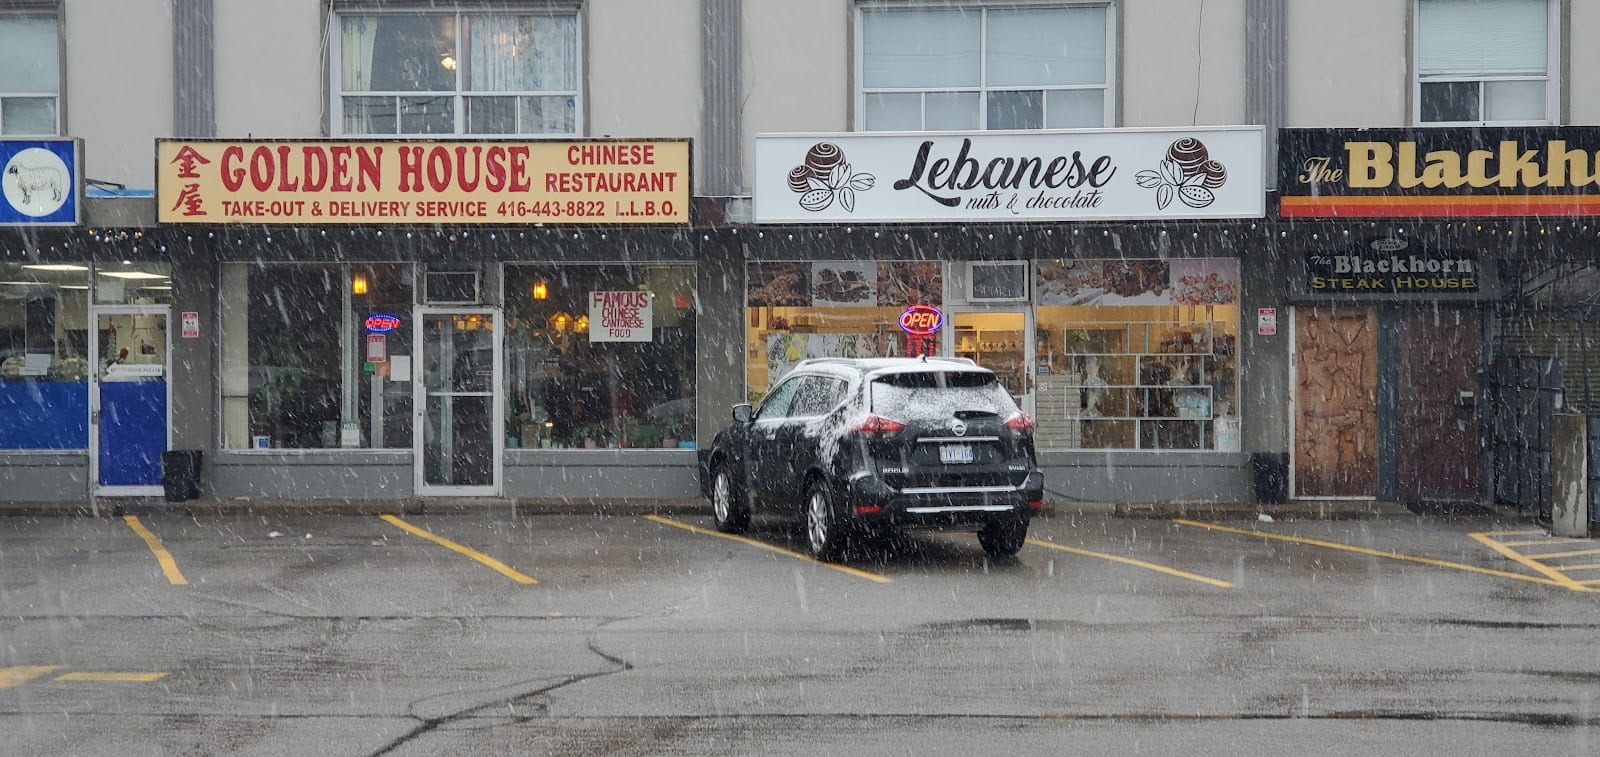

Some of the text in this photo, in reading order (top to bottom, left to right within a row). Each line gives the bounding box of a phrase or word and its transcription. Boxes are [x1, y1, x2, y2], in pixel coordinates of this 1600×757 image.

[567, 145, 655, 166] CHINESE
[220, 145, 532, 194] GOLDEN HOUSE
[893, 138, 1117, 208] Lebanese
[1300, 157, 1343, 183] The
[545, 171, 678, 193] RESTAURANT
[222, 200, 679, 217] TAKE-OUT & DELIVERY SERVICE 416-443-8822 L.L.B.O.
[965, 189, 1104, 214] nuts & chocolate
[1334, 255, 1472, 273] Blackhorn
[1312, 277, 1475, 289] STEAK HOUSE
[594, 292, 648, 309] FAMOUS
[602, 307, 640, 319] CHINESE
[902, 312, 940, 328] OPEN
[365, 318, 400, 328] OPEN
[602, 319, 645, 329] CANTONESE
[609, 328, 631, 338] FOOD
